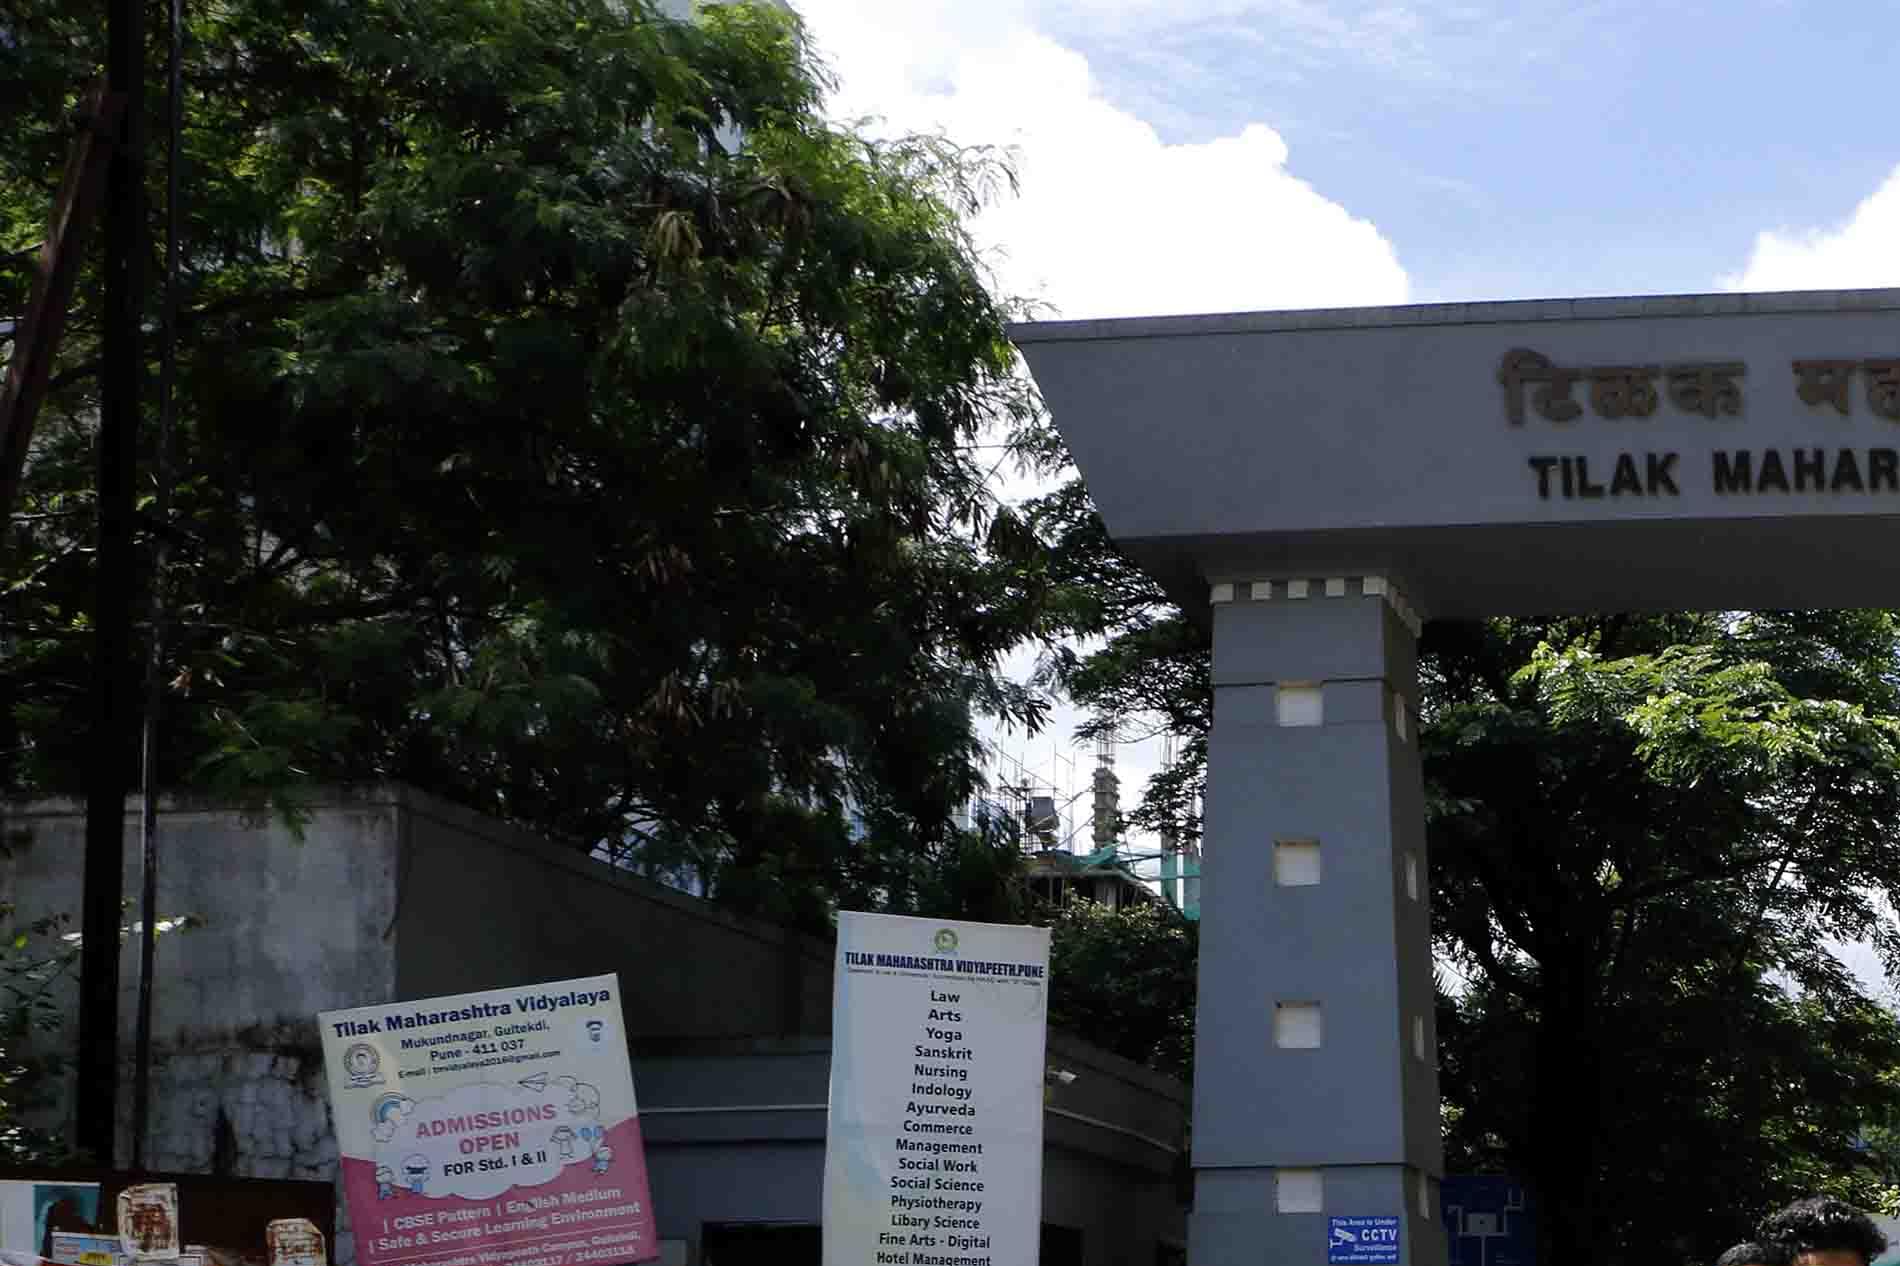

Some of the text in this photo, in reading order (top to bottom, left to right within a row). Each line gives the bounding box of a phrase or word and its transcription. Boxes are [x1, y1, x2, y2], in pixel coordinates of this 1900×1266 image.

[1496, 347, 1747, 428] टिळक
[1528, 452, 1680, 499] TILAK
[845, 951, 954, 973] TILAK MAHARASHTRA
[931, 990, 961, 1003] Law
[333, 988, 611, 1038] Tilak Maharashtra Vidyalaya
[927, 1008, 961, 1022] Arts
[926, 1027, 962, 1043] Yoga
[430, 1047, 462, 1062] Pune
[473, 1041, 498, 1056] 411
[500, 1038, 526, 1054] 037
[915, 1045, 973, 1060] Sanskrit
[914, 1064, 968, 1082] Nursing
[912, 1083, 973, 1100] Indology
[906, 1101, 976, 1117] Ayurveda
[415, 1103, 558, 1139] ADMISSIONS
[903, 1120, 973, 1136] Commerce
[459, 1131, 521, 1154] OPEN
[896, 1138, 983, 1156] Management
[443, 1160, 475, 1176] FOR
[478, 1157, 508, 1174] Std.
[520, 1153, 533, 1167] &
[899, 1157, 977, 1173] Social Work
[890, 1176, 984, 1192] Social Science
[393, 1213, 435, 1231] CBSE
[438, 1206, 491, 1224] Pattern
[562, 1187, 621, 1206] Medium
[891, 1195, 982, 1214] Physiotherapy
[377, 1200, 641, 1251] Safe & Secure Learning Environment
[891, 1214, 980, 1231] Libary Science
[879, 1232, 905, 1246] Fine
[909, 1233, 936, 1247] Arts
[948, 1235, 991, 1251] Digital
[1361, 1228, 1398, 1241] CCTV
[877, 1251, 909, 1265] Hotel
